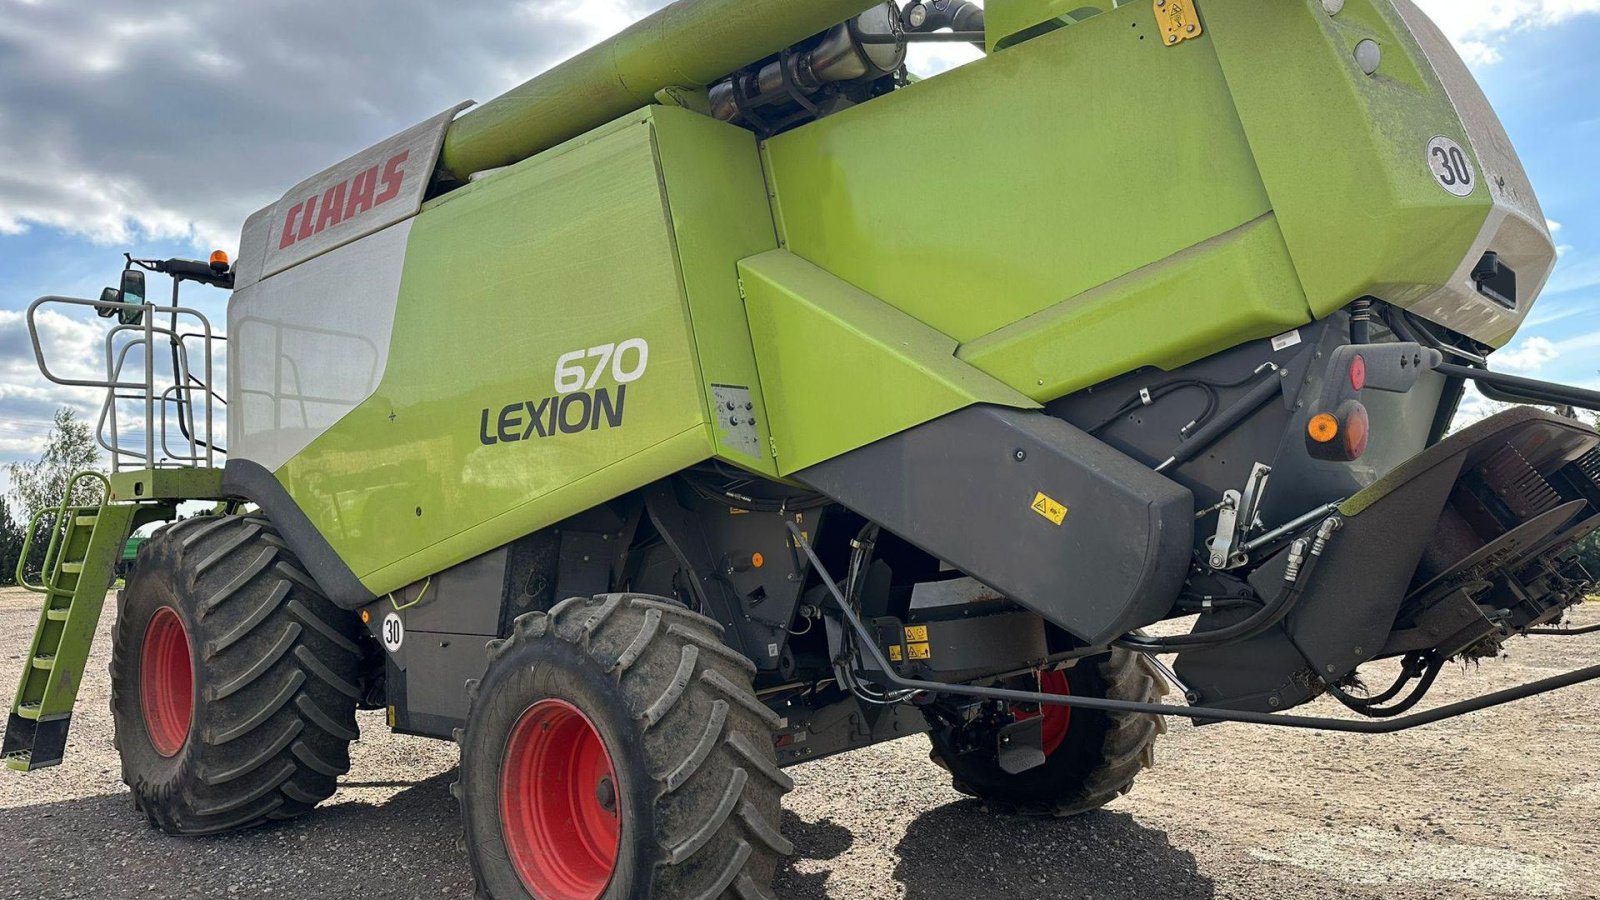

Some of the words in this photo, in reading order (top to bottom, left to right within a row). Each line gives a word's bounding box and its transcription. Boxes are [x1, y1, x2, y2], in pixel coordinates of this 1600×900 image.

[1431, 146, 1471, 186] 30
[279, 150, 410, 250] CLAAS
[554, 337, 649, 394] 670
[479, 383, 627, 446] LEXION
[385, 619, 400, 645] 30
